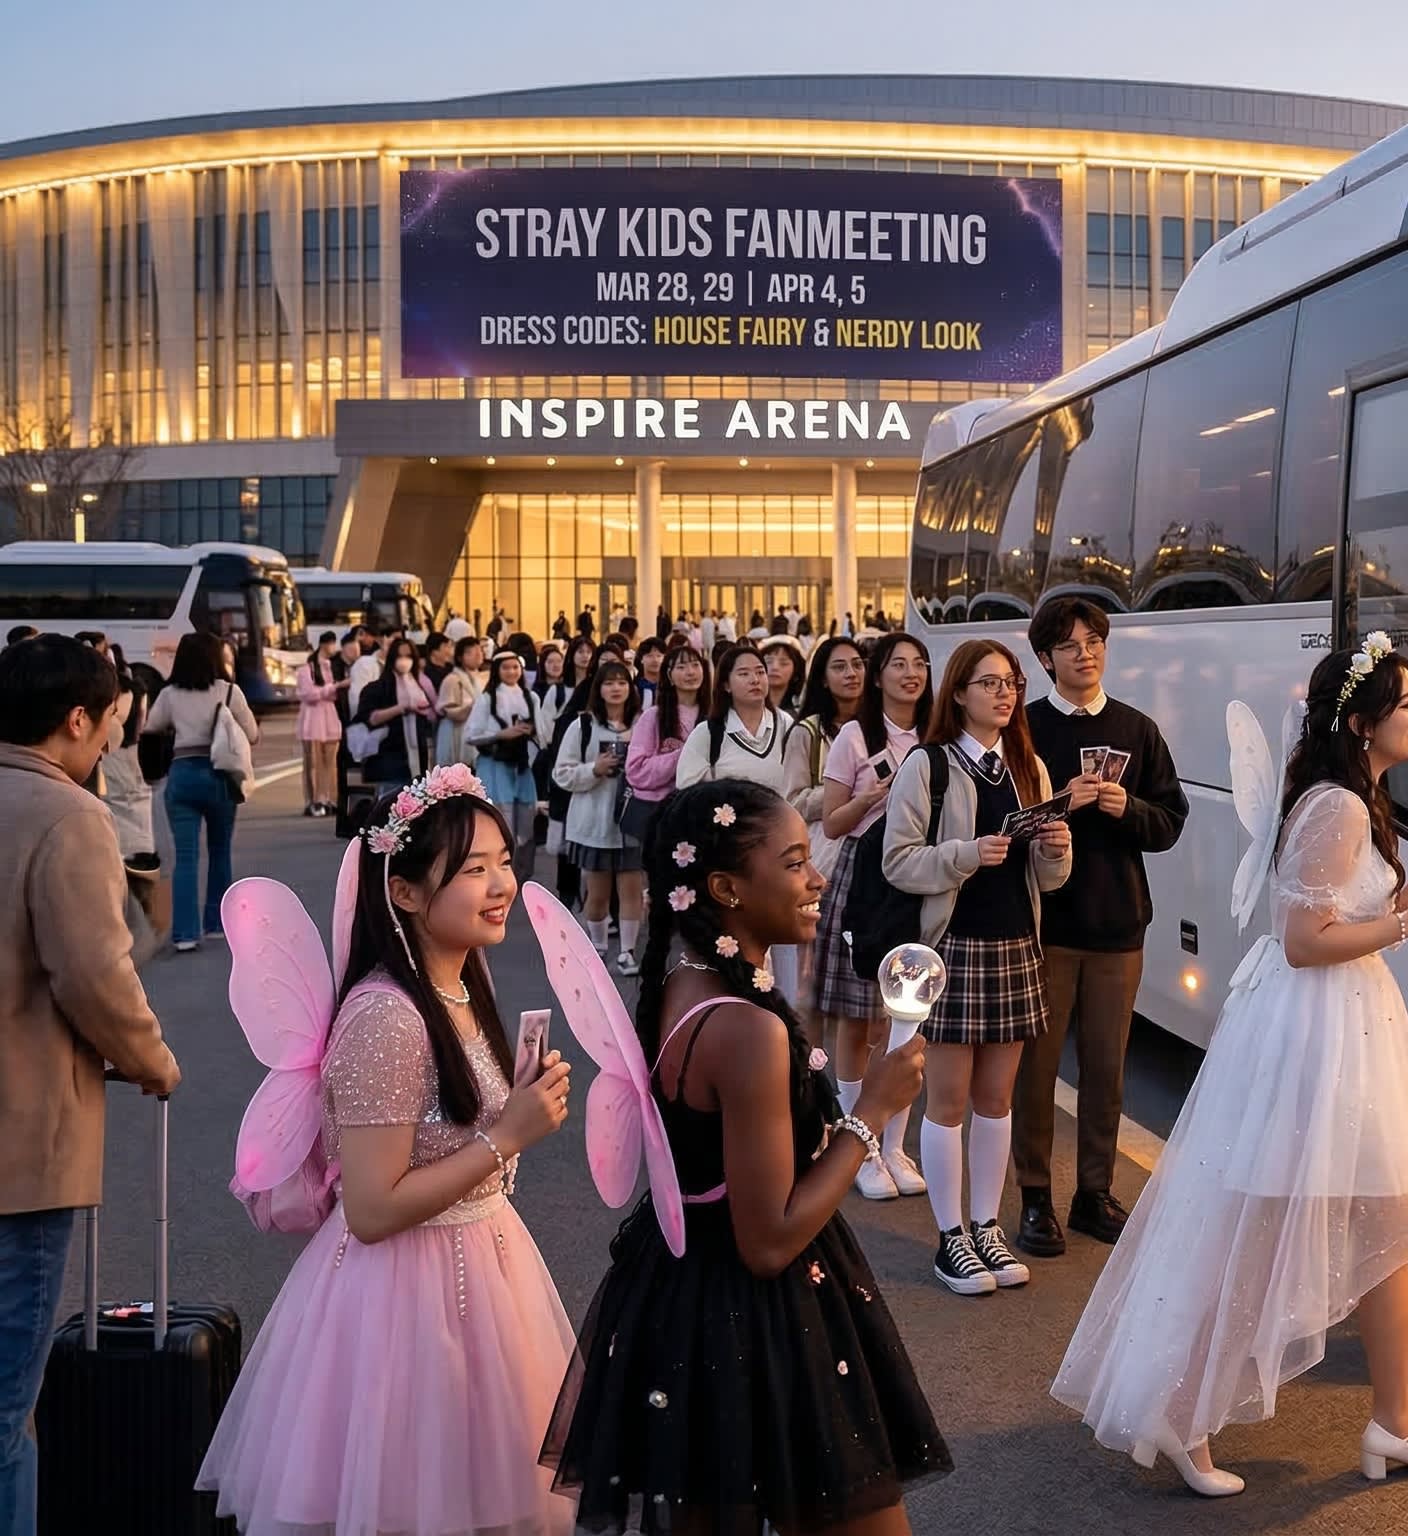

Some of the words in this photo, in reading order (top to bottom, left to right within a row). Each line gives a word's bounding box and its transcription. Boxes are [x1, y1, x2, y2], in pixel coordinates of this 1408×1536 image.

[475, 207, 606, 258] STRAY
[618, 207, 712, 257] KIDS
[726, 208, 987, 264] FANMEETING
[597, 272, 650, 302] MAR
[657, 272, 696, 307] 28,
[703, 272, 734, 302] 29
[767, 273, 814, 303] APR
[820, 274, 843, 308] 4,
[851, 275, 866, 305] 5
[481, 316, 556, 345] DRESS
[563, 316, 647, 345] CODES:
[654, 316, 731, 345] HOUSE
[739, 317, 807, 346] FAIRY
[814, 318, 830, 347] &
[836, 319, 914, 349] NERDY
[921, 320, 982, 351] LOOK
[479, 399, 701, 438] INSPIRE
[725, 400, 912, 441] ARENA
